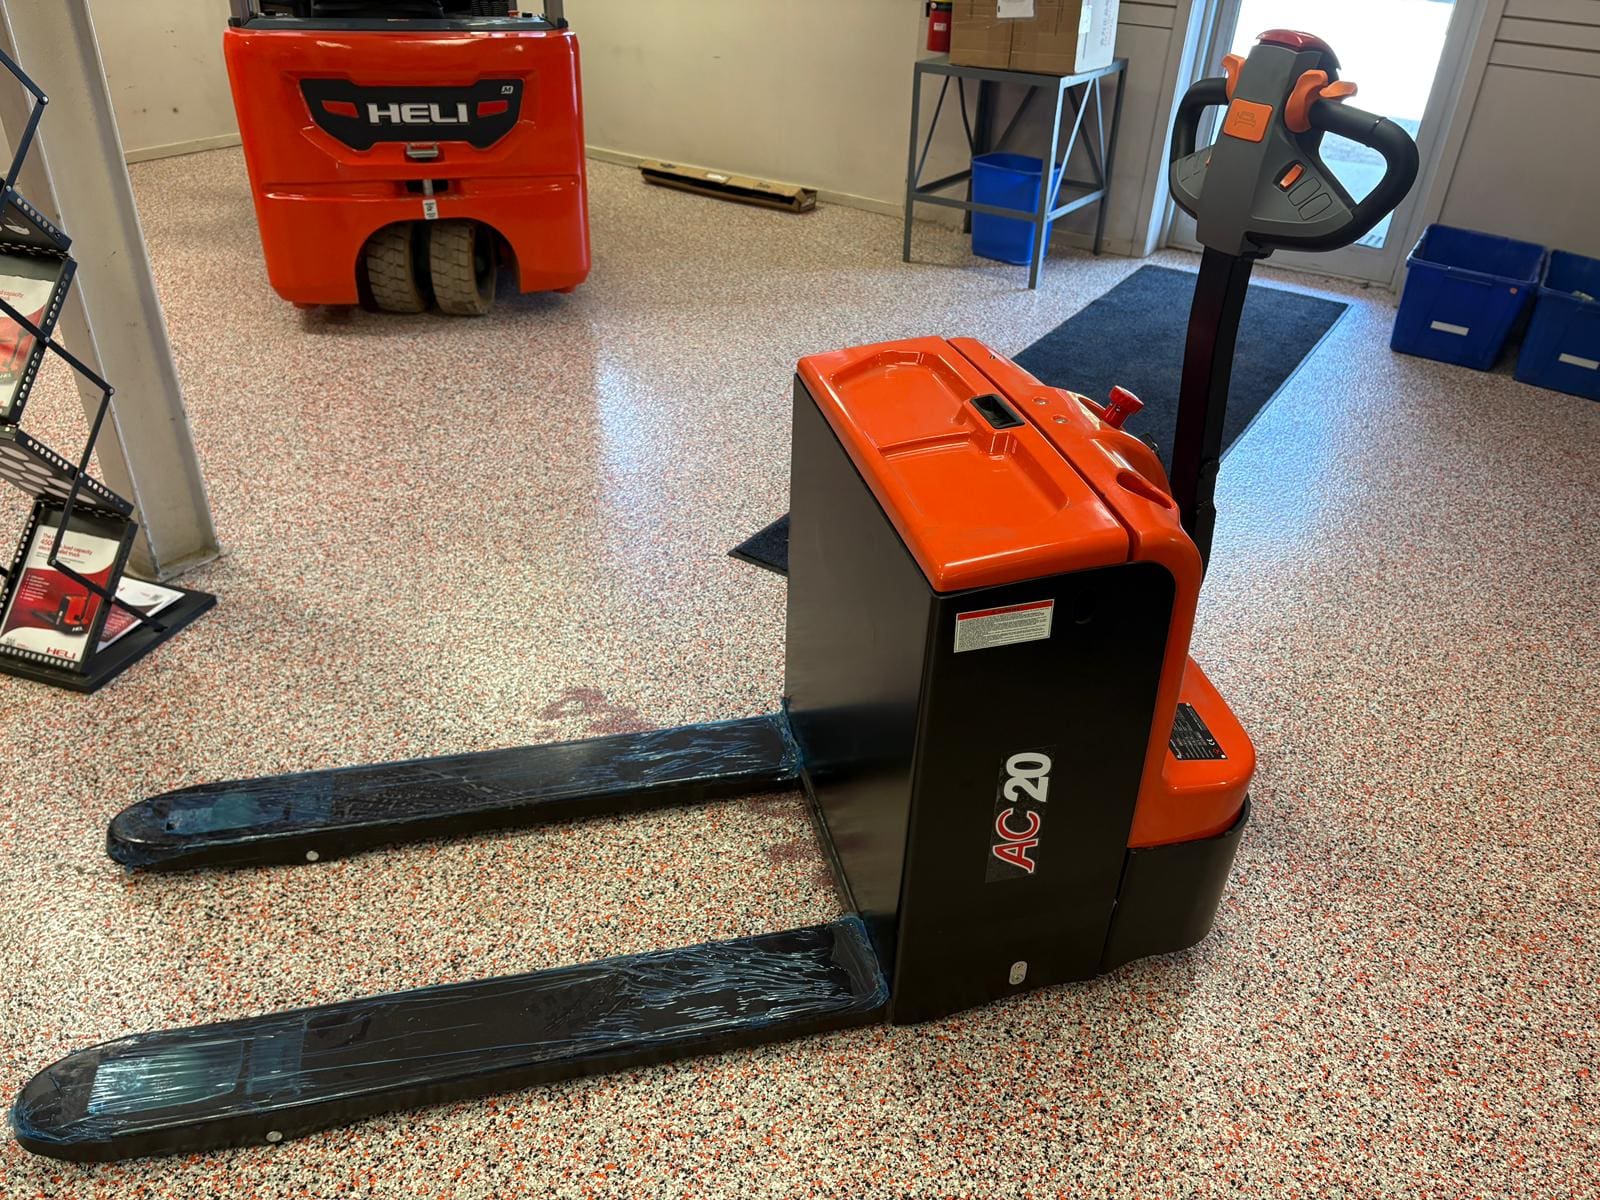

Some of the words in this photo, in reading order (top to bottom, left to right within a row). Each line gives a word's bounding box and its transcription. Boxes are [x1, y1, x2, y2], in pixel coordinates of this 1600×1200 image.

[366, 102, 470, 124] HELI
[73, 547, 93, 556] capacity
[46, 646, 76, 660] HELI
